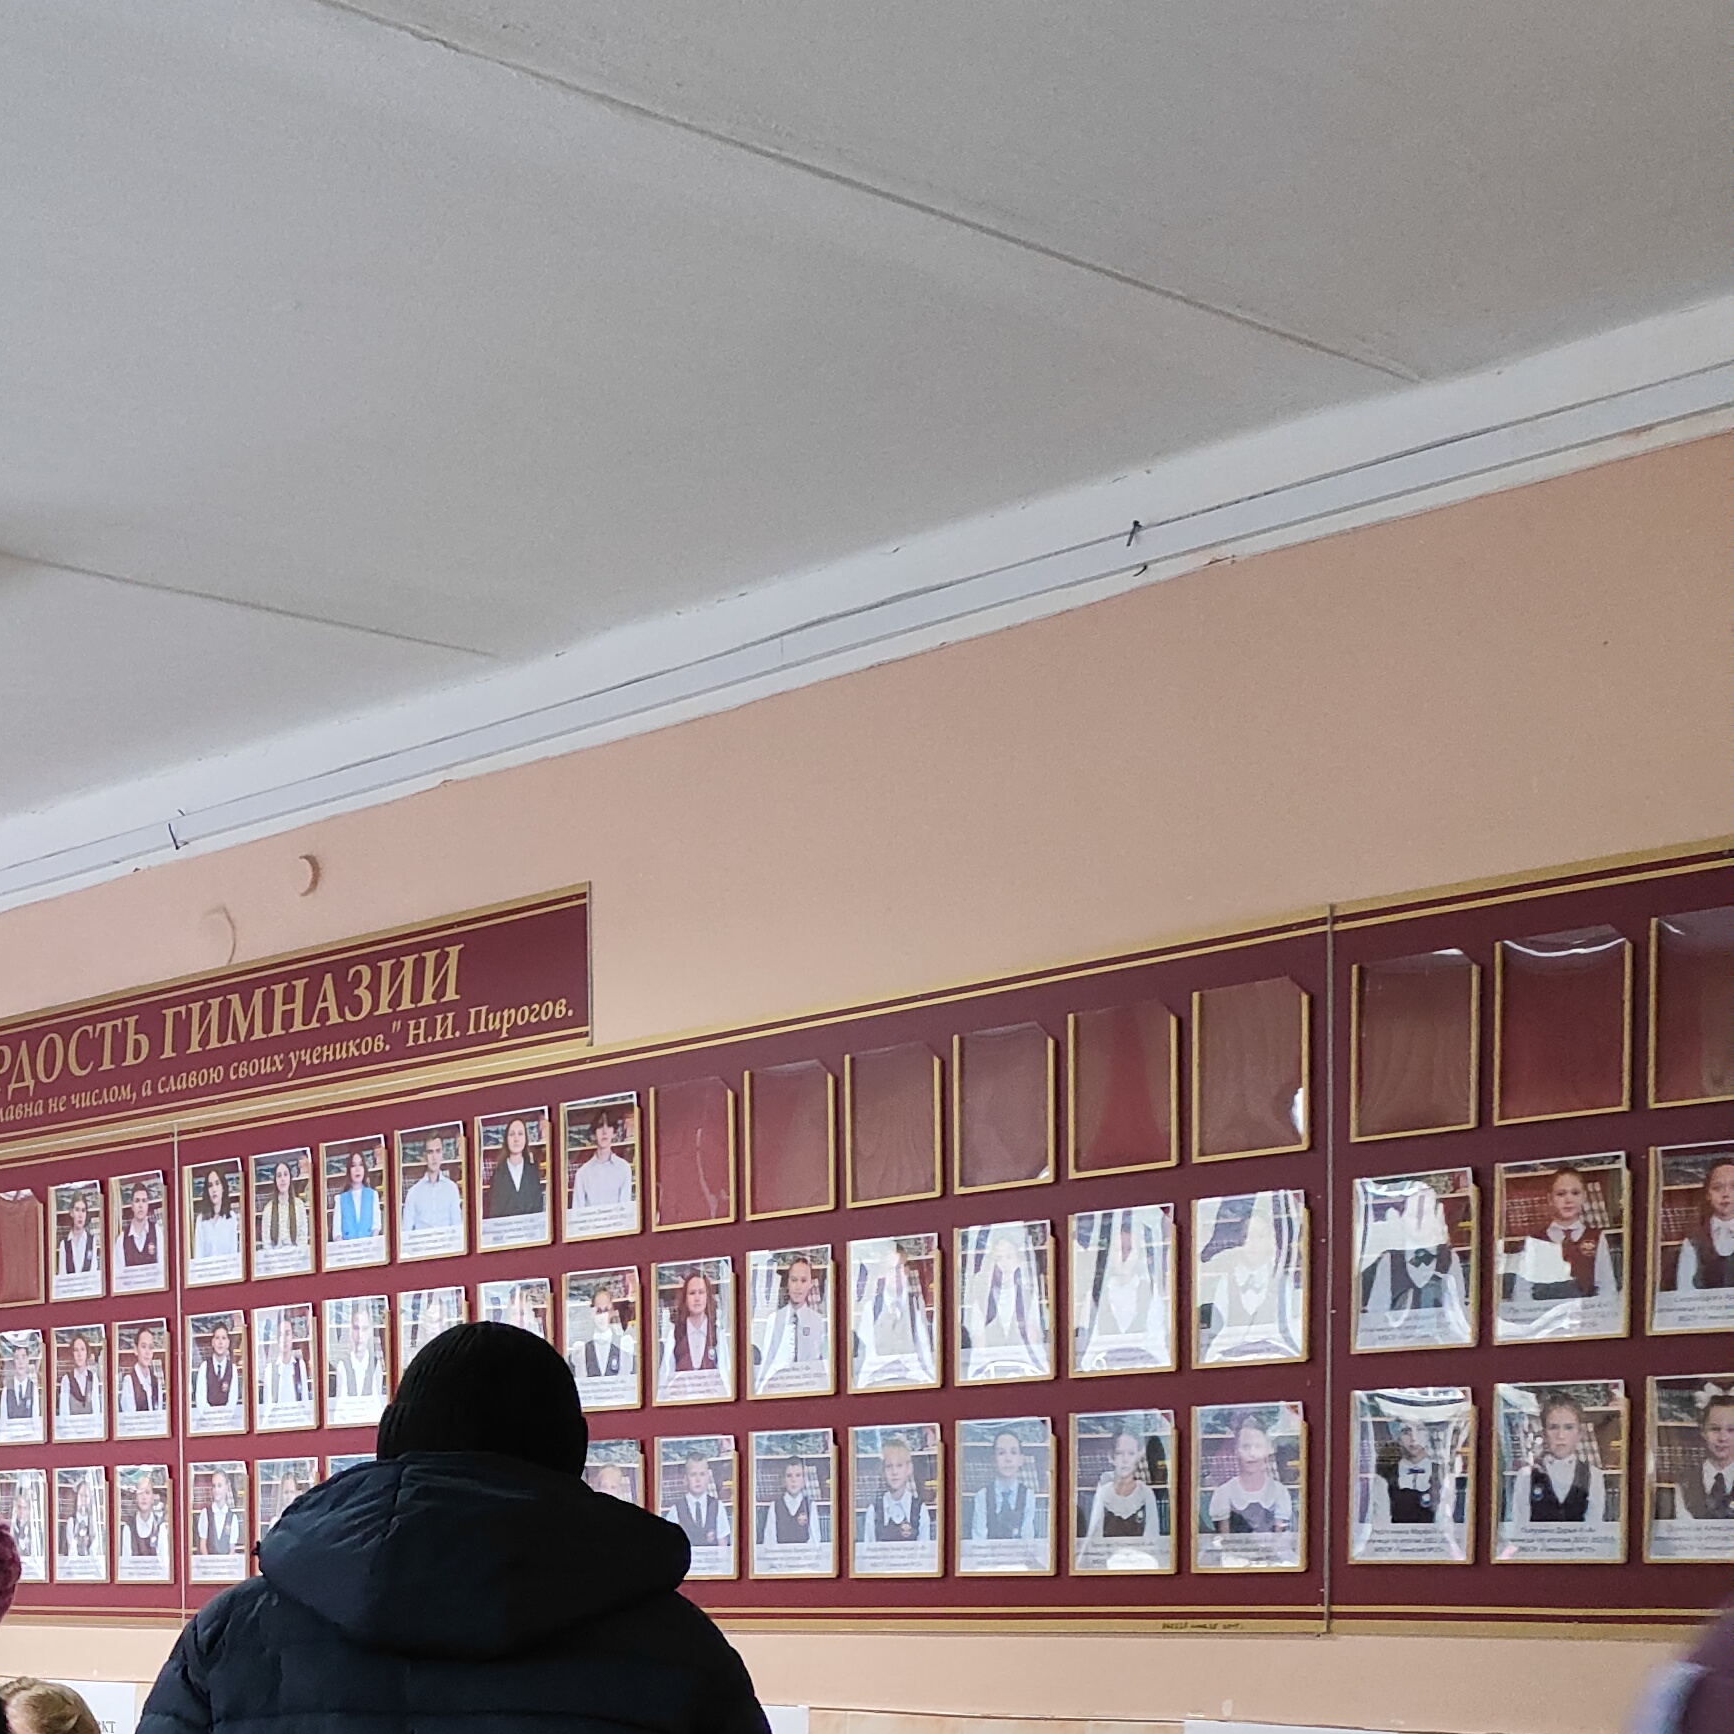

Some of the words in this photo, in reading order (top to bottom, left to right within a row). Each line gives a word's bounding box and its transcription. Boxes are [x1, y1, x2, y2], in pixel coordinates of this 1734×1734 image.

[48, 1094, 66, 1114] не
[70, 1082, 136, 1106] числом,
[141, 1079, 152, 1097] а
[157, 1065, 224, 1094] славою
[229, 1053, 284, 1080] своих
[405, 1011, 461, 1047] Н.И.
[466, 997, 574, 1038] Пирогов.
[160, 943, 464, 1059] ГИМНАЗИИ
